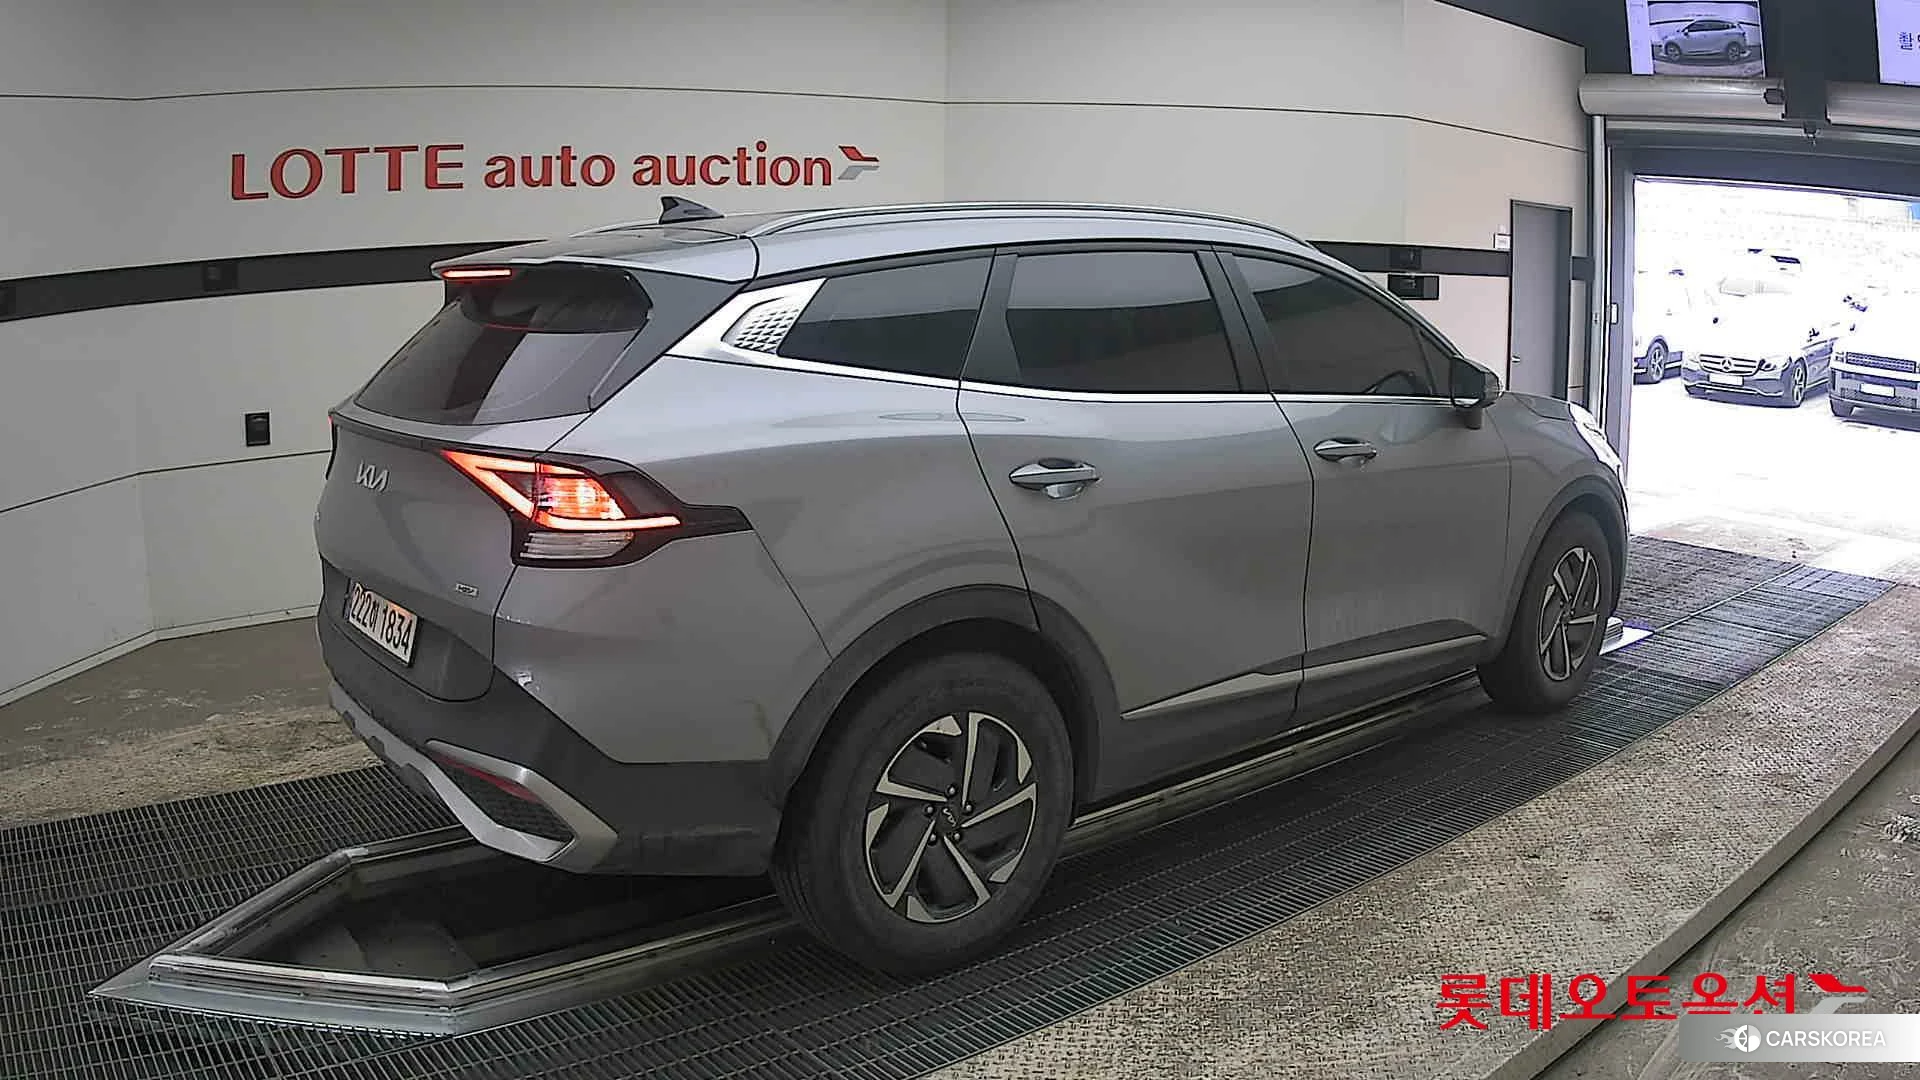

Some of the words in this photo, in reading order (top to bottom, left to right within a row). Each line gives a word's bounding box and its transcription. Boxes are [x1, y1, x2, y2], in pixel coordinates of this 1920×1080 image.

[231, 144, 464, 199] LOTTE
[484, 146, 617, 188] auto
[633, 141, 832, 186] auction
[355, 460, 390, 492] KIA
